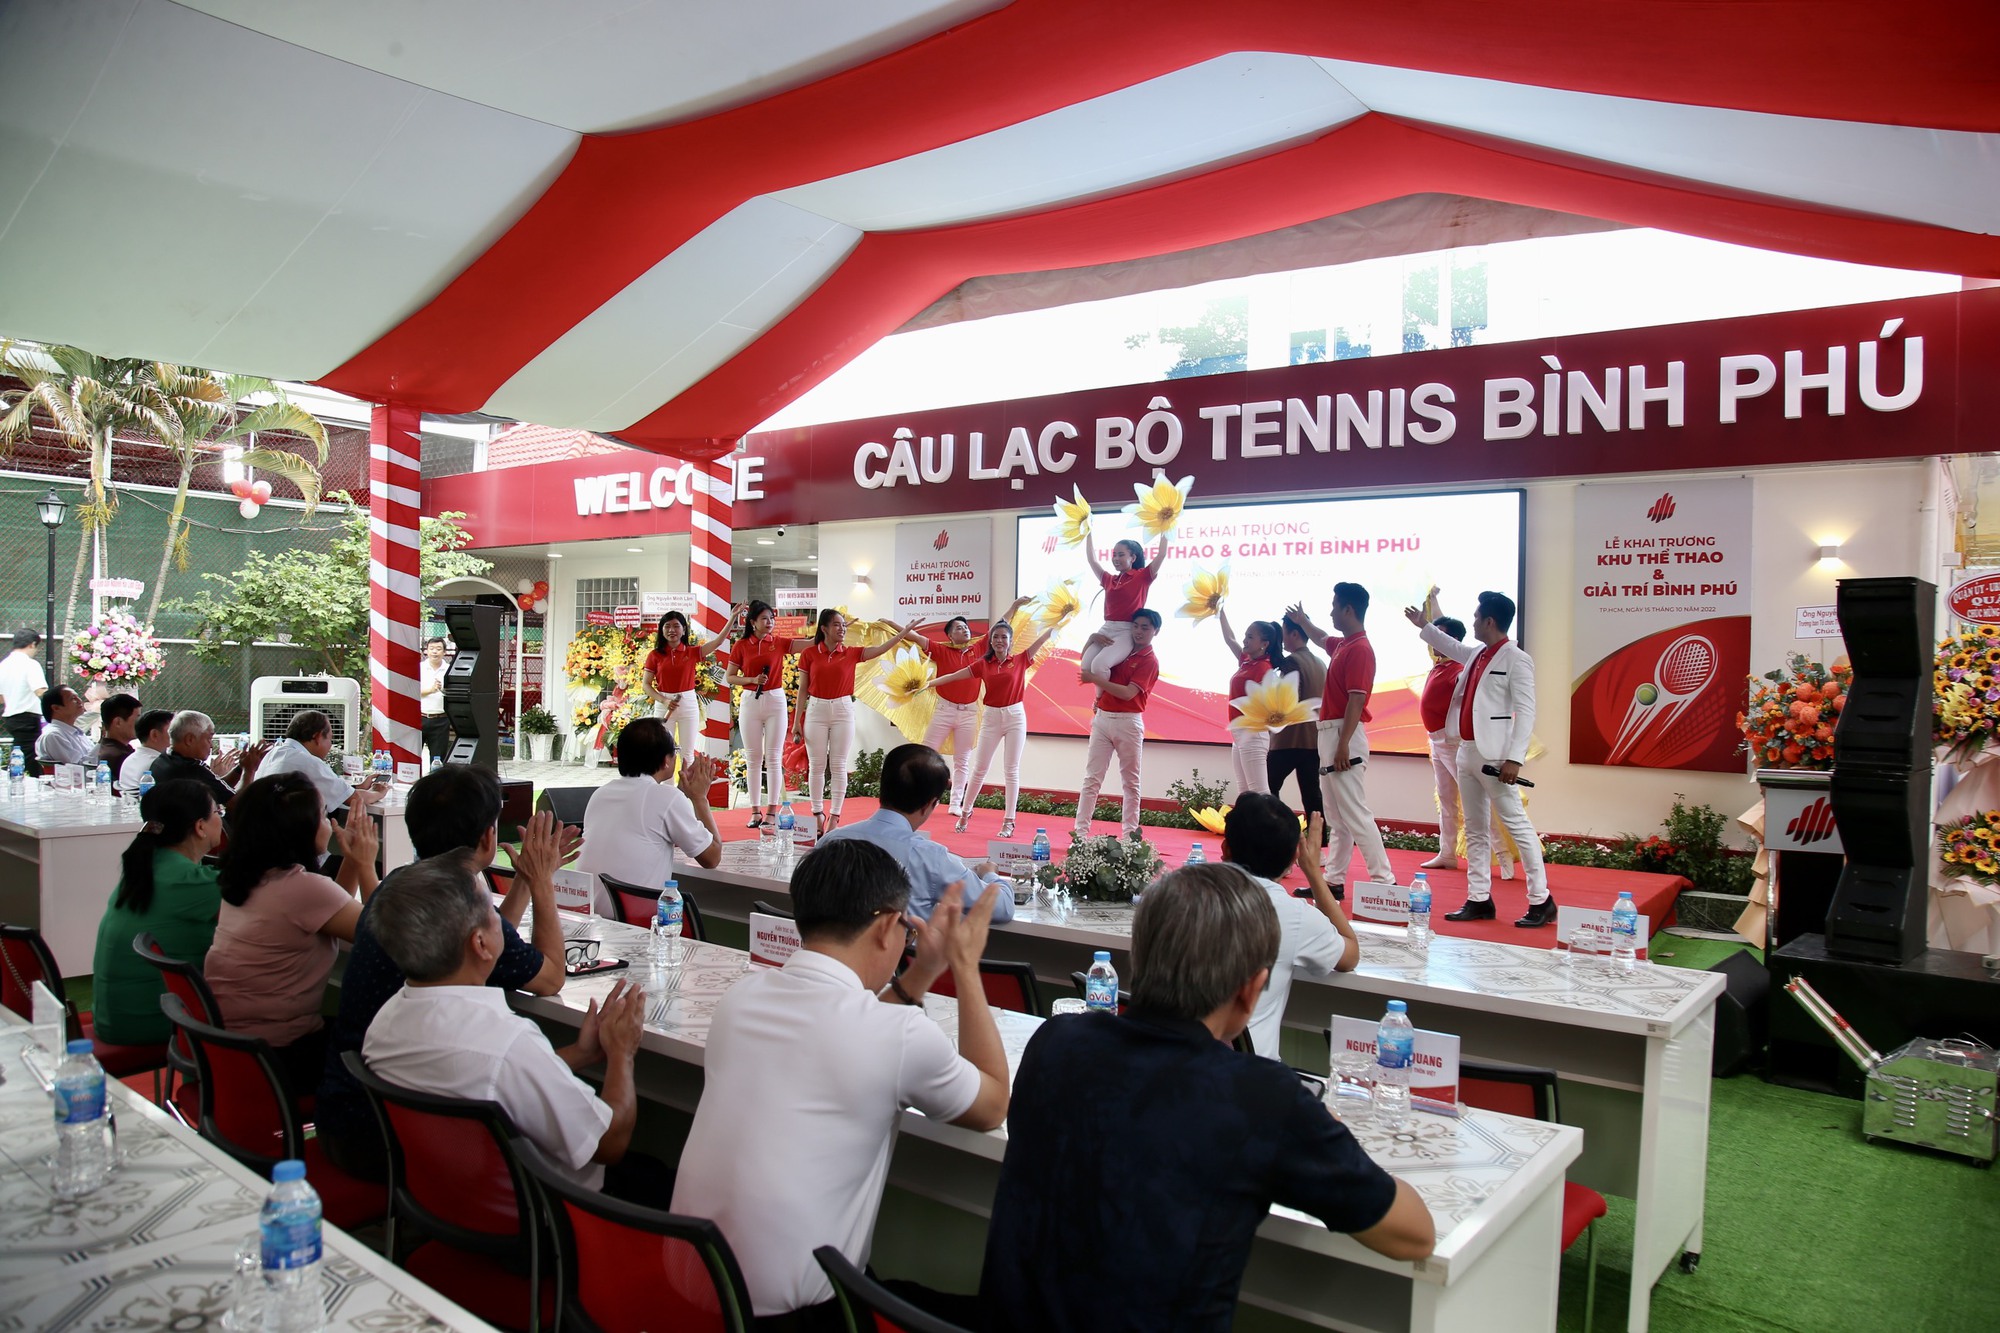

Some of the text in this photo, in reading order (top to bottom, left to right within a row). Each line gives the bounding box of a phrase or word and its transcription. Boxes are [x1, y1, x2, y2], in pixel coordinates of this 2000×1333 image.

[854, 318, 1923, 490] CÂU LẠC BỘ TENNIS BÌNH PHÚ
[574, 457, 765, 516] WELCOE
[1200, 526, 1236, 538] KHAI
[1167, 544, 1214, 560] THAO
[1320, 537, 1369, 554] BÌNH
[1377, 534, 1420, 552] PHÚ
[1605, 536, 1715, 548] LỄ KHAI TRƯƠNG
[1597, 549, 1723, 565] KHU THỂ THAO
[907, 574, 925, 582] KHU
[948, 571, 974, 580] THAO
[1653, 569, 1664, 580] &
[936, 584, 942, 592] &
[1584, 581, 1737, 597] GIẢI TRÍ BÌNH PHÚ
[899, 592, 981, 605] GIẢI TRÍ BÌNH PHÚ
[1361, 896, 1383, 905] NGUYỄN
[757, 931, 777, 942] NGUYỄN
[1088, 992, 1111, 1002] aVie
[1346, 1040, 1376, 1055] NGUYỄ
